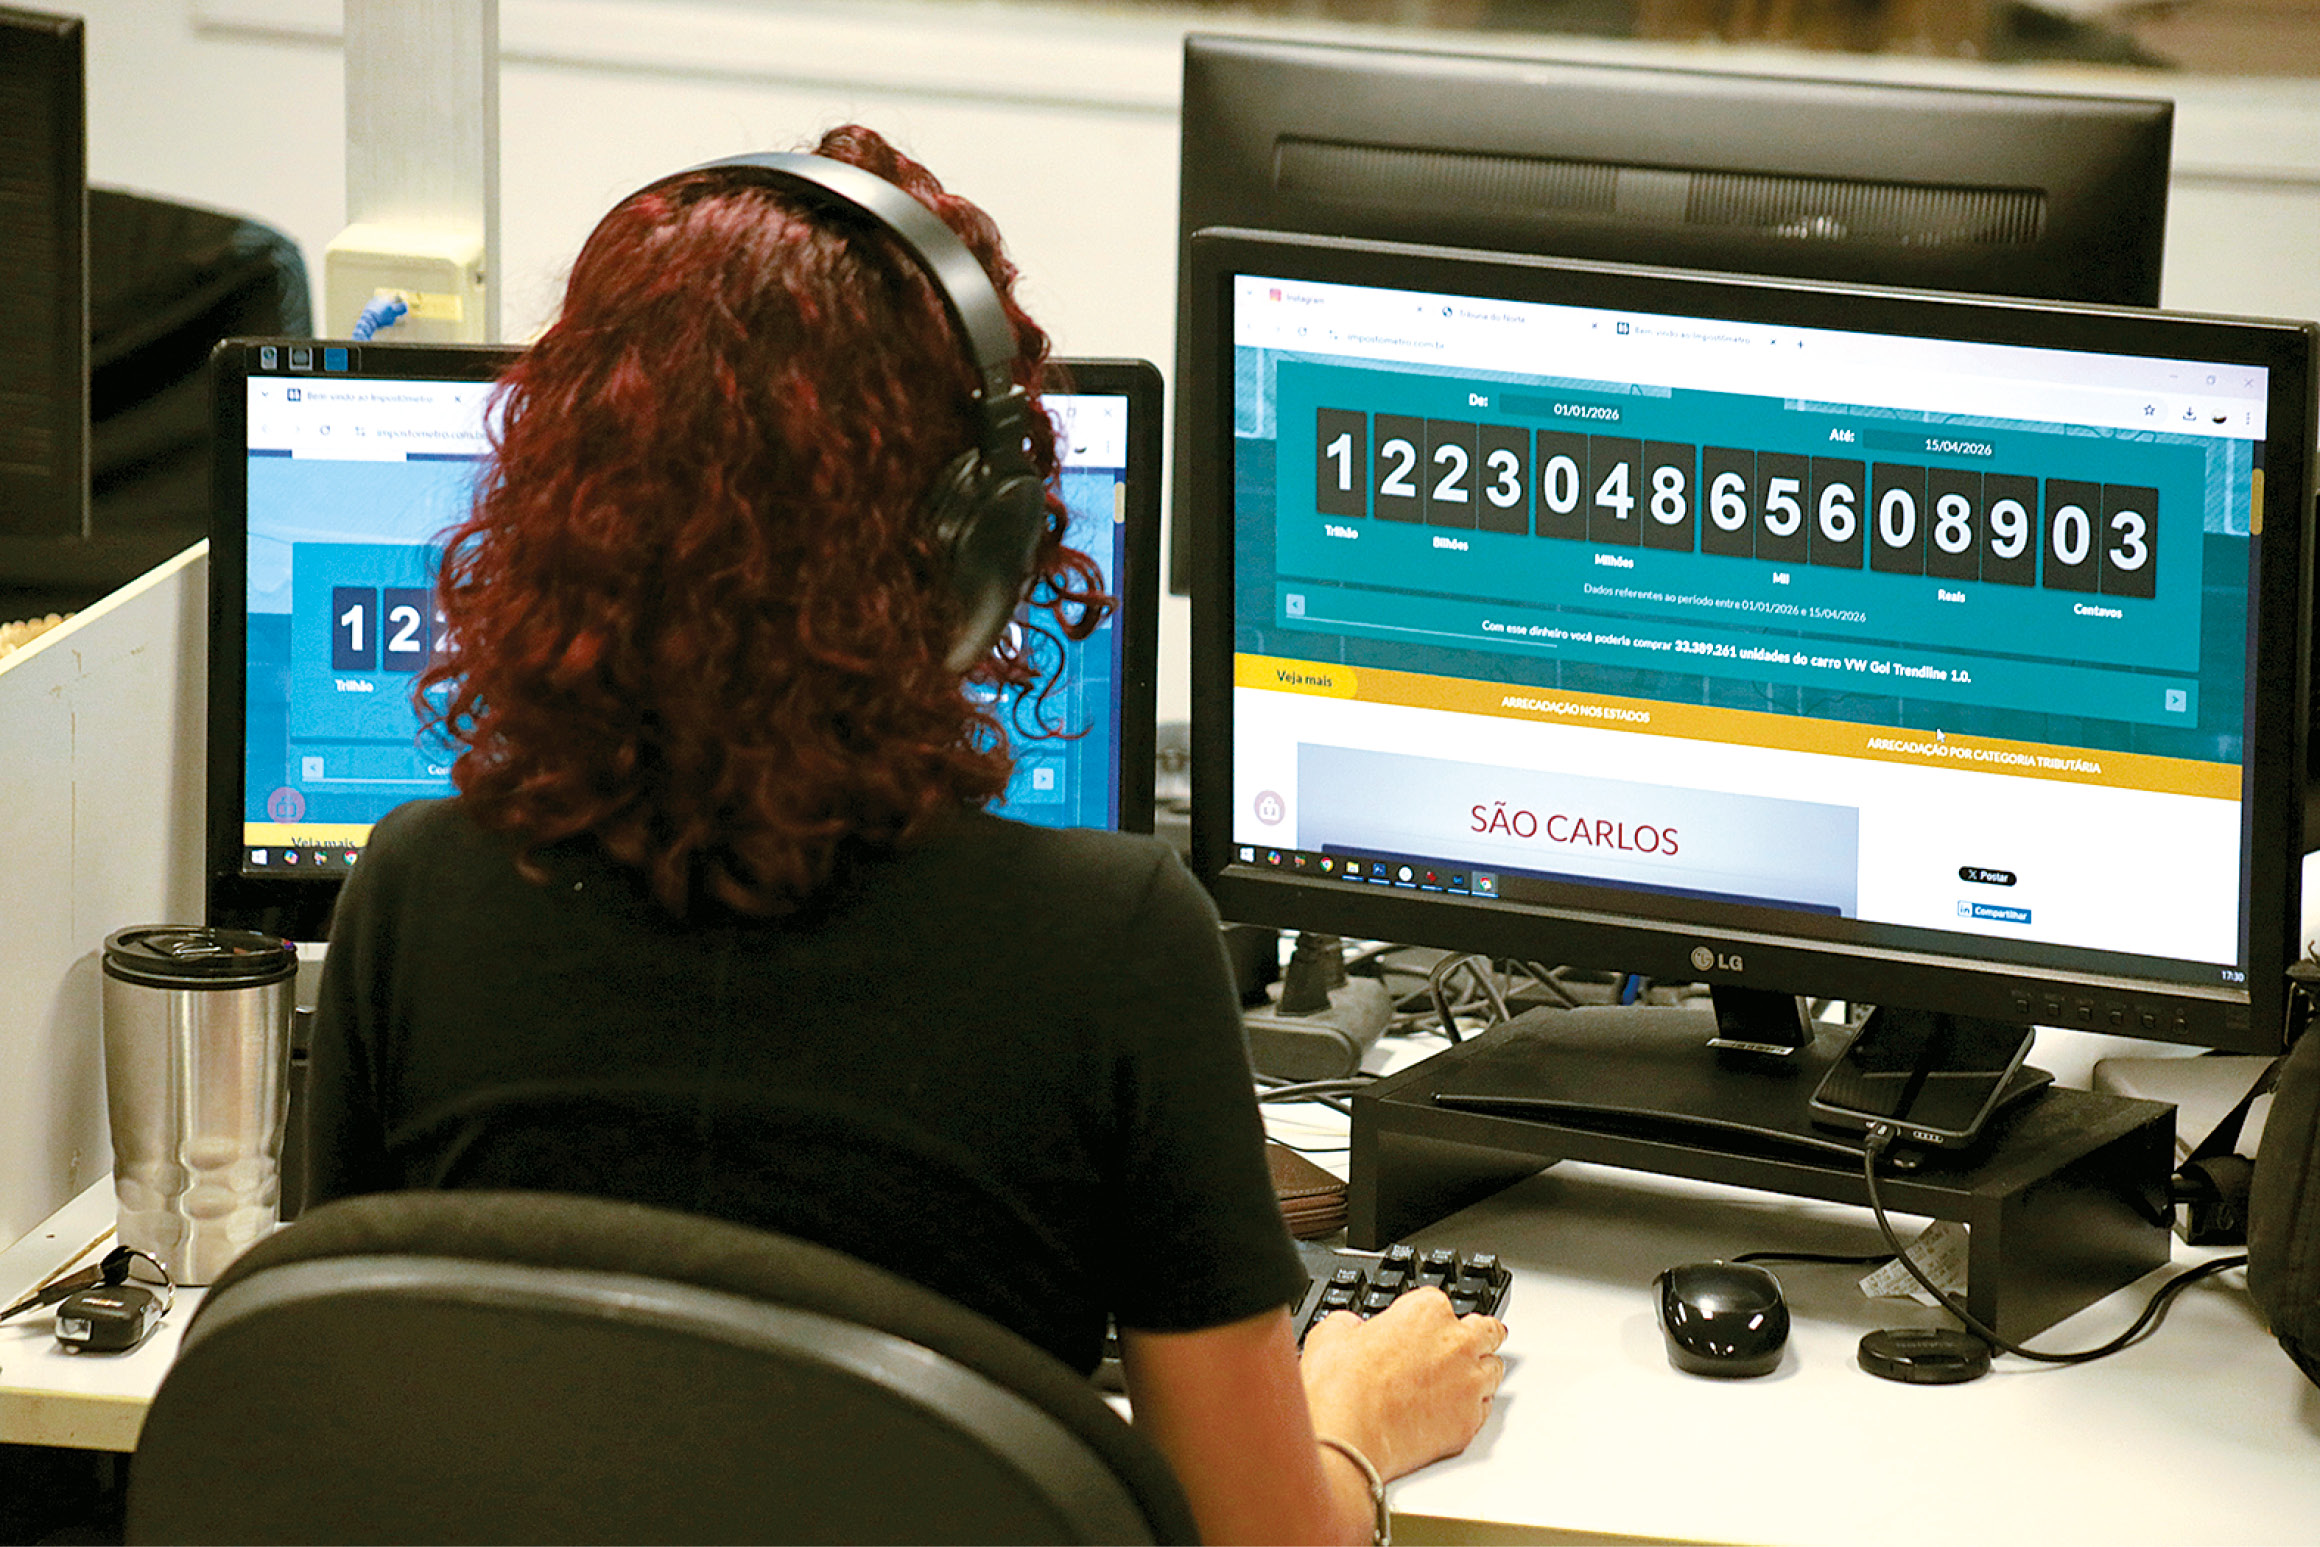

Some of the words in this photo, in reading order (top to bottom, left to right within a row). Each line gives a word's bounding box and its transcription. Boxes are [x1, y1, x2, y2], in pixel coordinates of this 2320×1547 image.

[1286, 294, 1325, 305] Instagram
[1503, 314, 1525, 323] Norte
[1469, 393, 1488, 408] De:
[1553, 403, 1620, 421] 01/01/2026
[1829, 427, 1855, 444] Até:
[1925, 437, 1992, 457] 15/04/2026
[1326, 433, 1352, 491] 1
[1324, 524, 1359, 540] Trilhão
[1433, 537, 1469, 552] Bilhões
[1594, 553, 1635, 569] Milhões
[1773, 572, 1790, 586] Mil
[1584, 582, 1614, 596] Dados
[1615, 586, 1663, 602] referentes
[1664, 594, 1676, 604] ao
[1677, 592, 1714, 611] período
[1715, 598, 1740, 610] entre
[1741, 600, 1799, 616] 01/01/2026
[1809, 607, 1867, 623] 15/04/2026
[1938, 589, 1966, 603] Reais
[2074, 603, 2123, 619] Centavos
[1482, 620, 1504, 633] Com
[1507, 624, 1527, 635] esse
[1529, 624, 1568, 640] dinheiro
[1570, 628, 1592, 642] você
[1594, 631, 1630, 648] poderia
[1633, 637, 1672, 652] comprar
[1675, 639, 1737, 659] 33.389.261
[1739, 647, 1790, 665] unidades
[1793, 652, 1808, 666] do
[1810, 655, 1841, 670] carro
[1843, 658, 1868, 672] VW
[1870, 661, 1890, 675] Gol
[1893, 663, 1947, 681] Trendline
[1951, 669, 1972, 683] 1.0.
[335, 679, 374, 693] Trilhão
[1276, 669, 1302, 686] Veja
[1305, 672, 1333, 688] mais
[1501, 695, 1579, 717] ARRECADAÇÃO
[1580, 704, 1603, 718] NOS
[1603, 706, 1650, 723] ESTADOS
[1867, 737, 1948, 758] ARRECADAÇÃO
[1949, 746, 1973, 760] POR
[1974, 749, 2036, 768] CATEGORIA
[2037, 754, 2101, 774] TRIBUTÁRIA
[1471, 801, 1538, 838] SÃO
[1547, 814, 1679, 856] CARLOS
[1980, 870, 2009, 883] Postar
[1974, 906, 2028, 921] Compartilhar
[1718, 953, 1743, 971] LG
